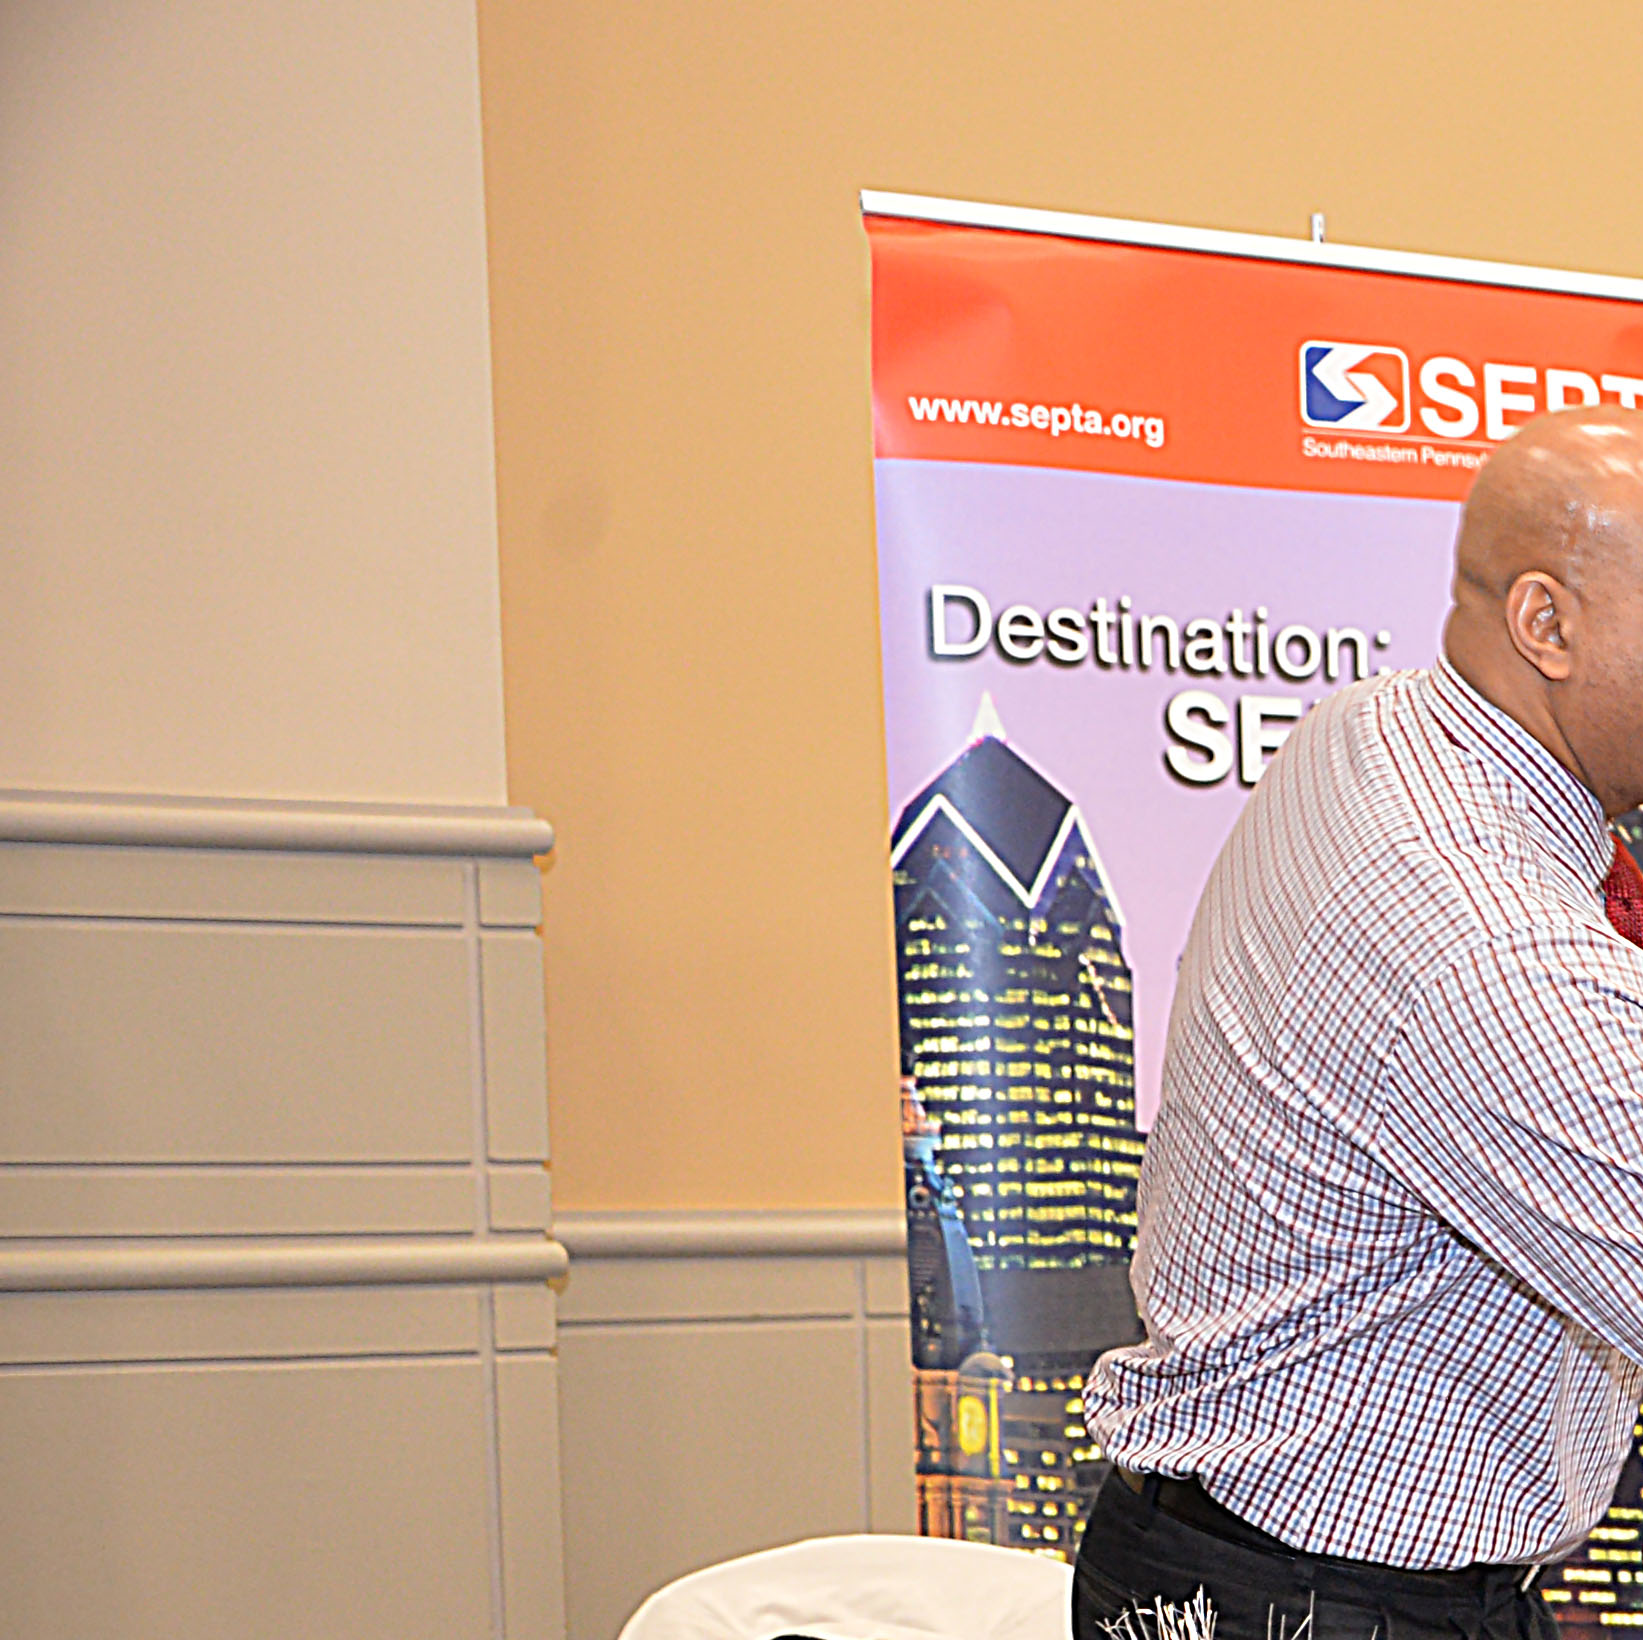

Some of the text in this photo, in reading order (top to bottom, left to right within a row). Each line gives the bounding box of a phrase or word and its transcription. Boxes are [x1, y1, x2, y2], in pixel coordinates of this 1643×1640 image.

[908, 396, 1165, 448] www.septa.org
[1302, 436, 1419, 465] Southeastern
[929, 584, 1392, 681] Destination:
